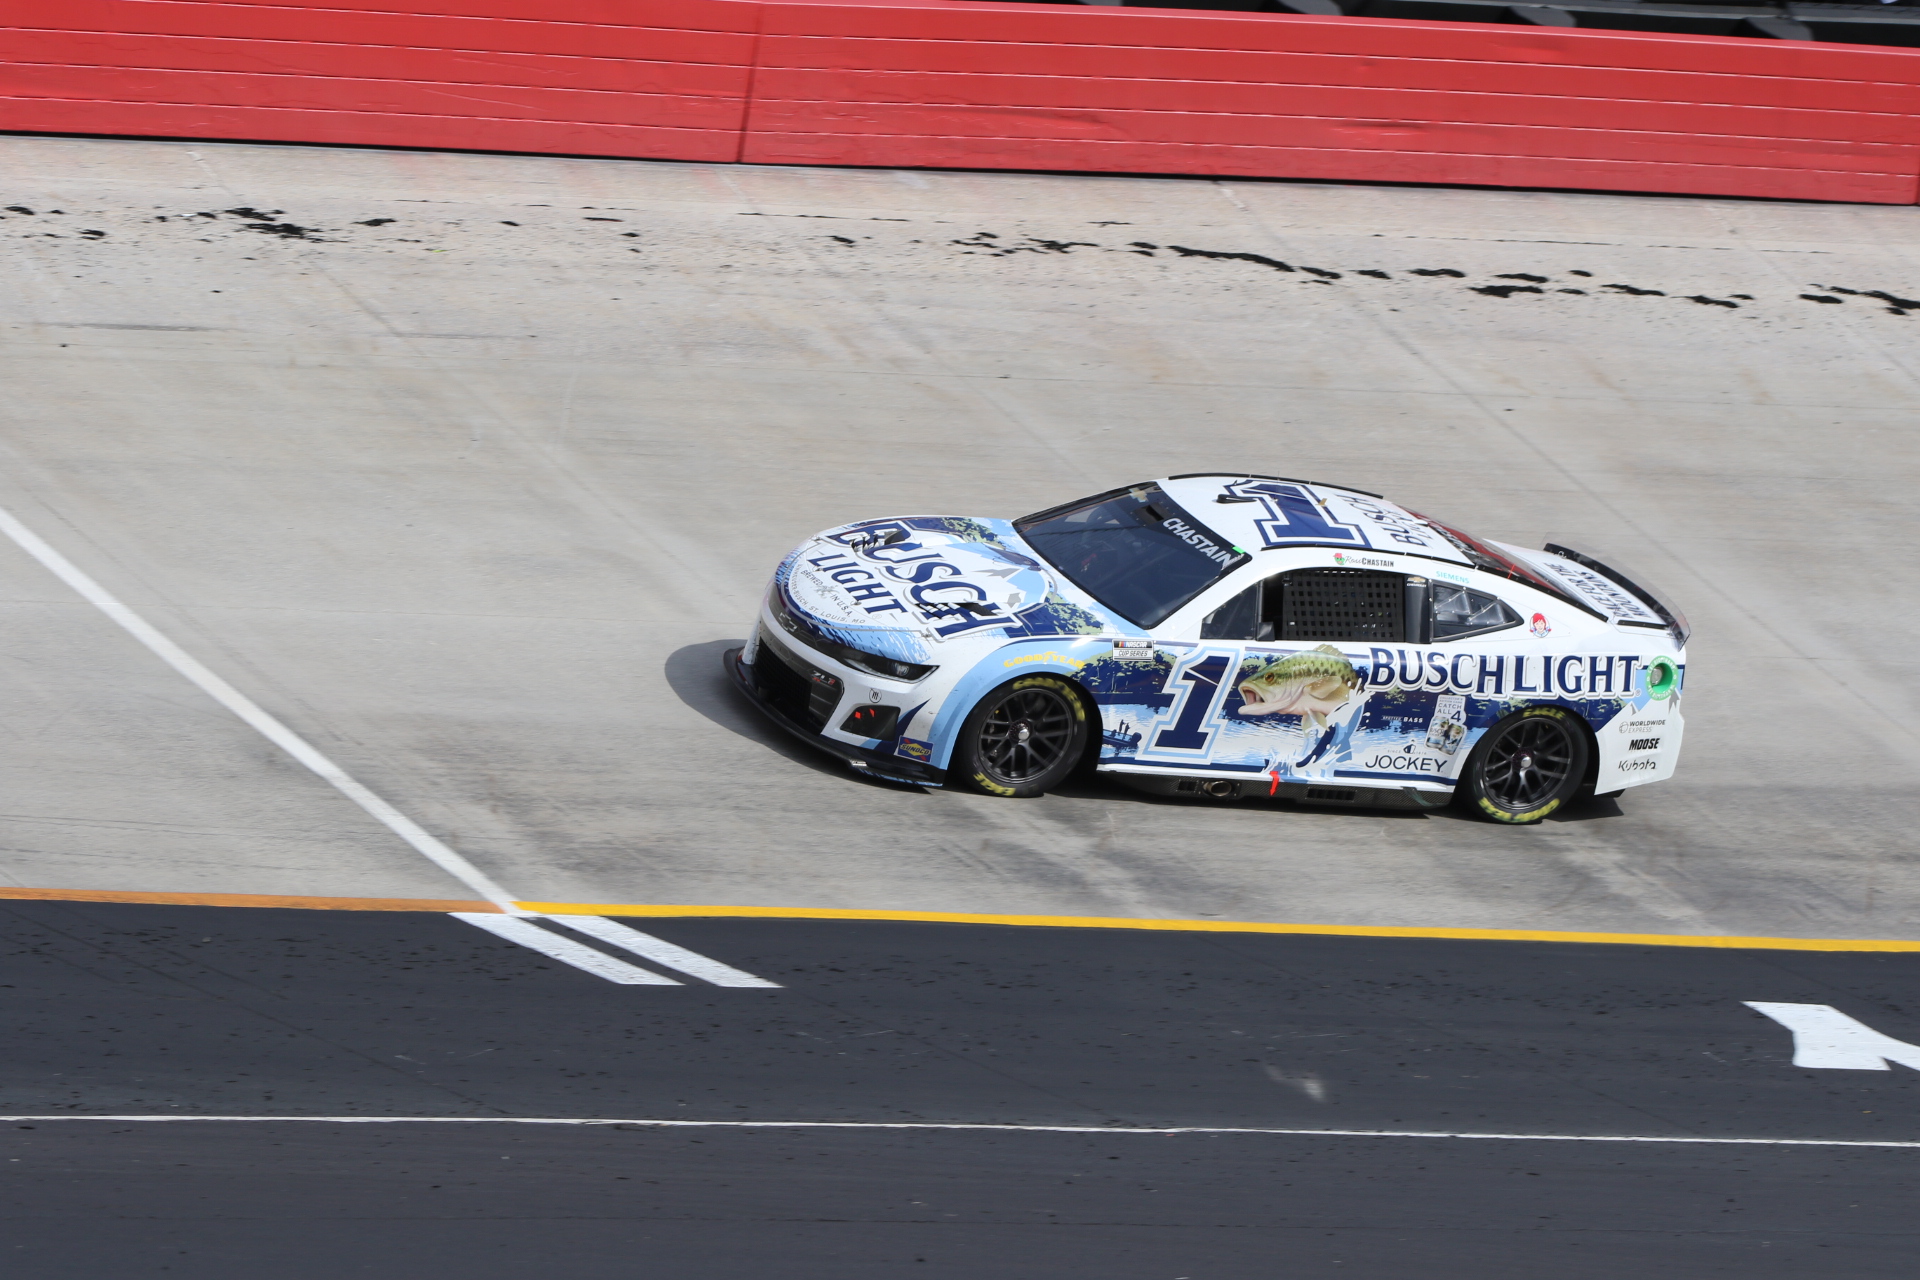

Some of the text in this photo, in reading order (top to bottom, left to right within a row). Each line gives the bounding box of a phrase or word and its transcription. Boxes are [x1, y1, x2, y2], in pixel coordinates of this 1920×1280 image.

[1232, 482, 1364, 544] 1
[1334, 494, 1428, 547] BUSCH
[1163, 517, 1233, 570] CHASTAIN
[1361, 557, 1394, 567] CHASTAIN
[807, 553, 908, 614] LIGHT
[1435, 570, 1470, 584] SIEMENS
[1004, 651, 1085, 669] GOODYEAR
[1146, 649, 1237, 756] 1
[1438, 702, 1462, 710] CATCH
[1451, 710, 1462, 722] 4
[1629, 719, 1666, 727] WORLDWIDE
[901, 743, 931, 756] SUNOCO
[1629, 738, 1660, 751] MOOSE
[1365, 755, 1448, 773] JOCKEY
[1618, 759, 1657, 771] Kubota
